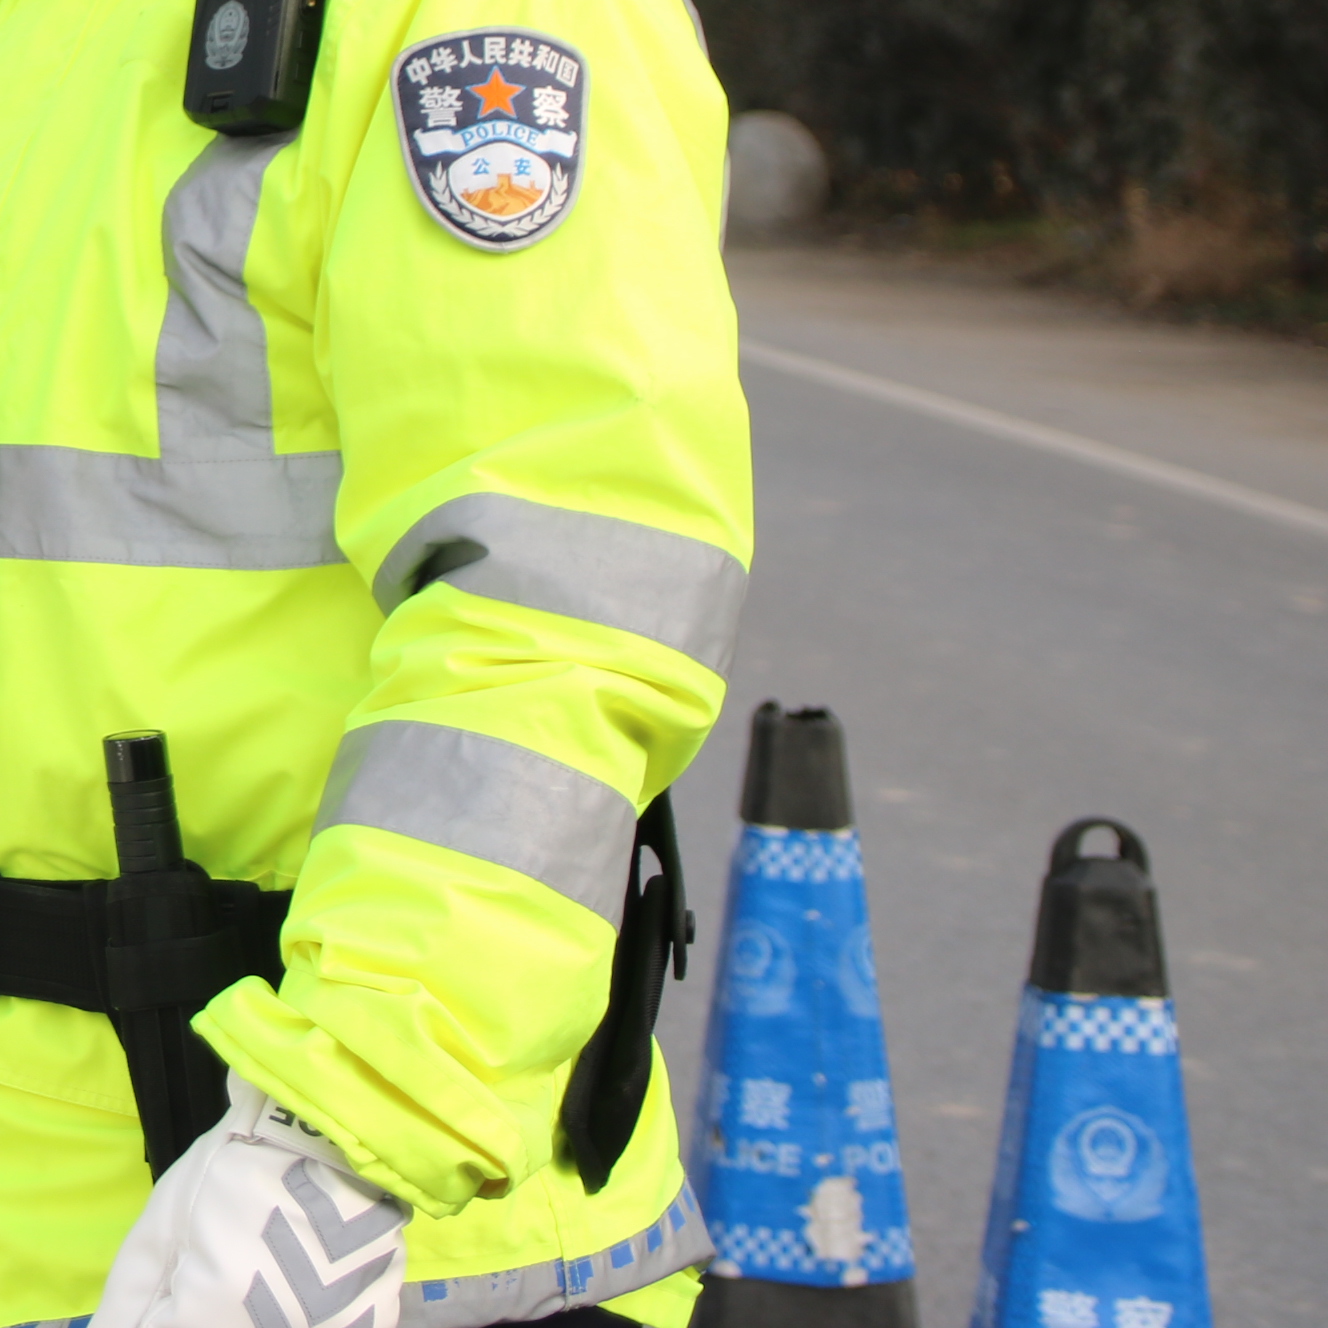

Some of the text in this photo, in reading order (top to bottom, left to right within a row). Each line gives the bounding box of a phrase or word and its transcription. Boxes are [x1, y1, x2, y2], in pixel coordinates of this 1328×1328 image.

[406, 36, 580, 88] 中华人民共和国
[461, 122, 538, 147] POLICE
